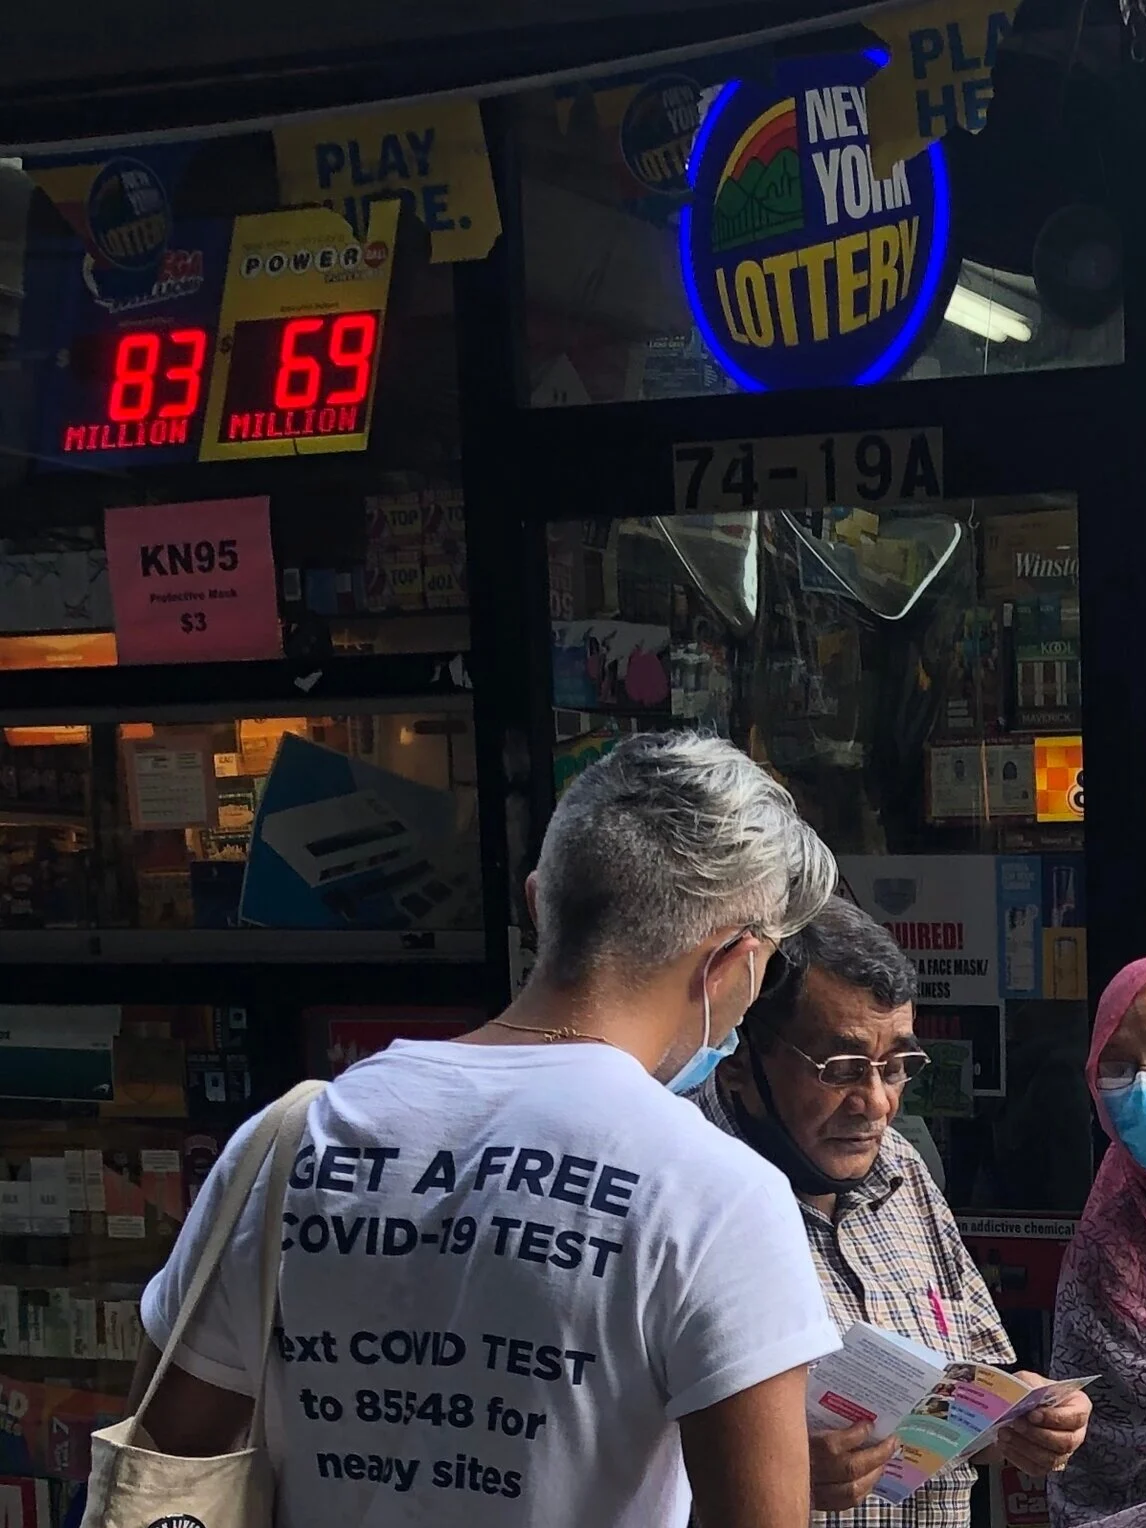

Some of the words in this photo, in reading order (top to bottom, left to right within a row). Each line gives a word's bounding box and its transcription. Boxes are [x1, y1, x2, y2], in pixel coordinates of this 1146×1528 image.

[908, 11, 1016, 80] PLA
[916, 77, 994, 138] HE
[315, 124, 435, 189] PLAY
[245, 243, 362, 276] POWER
[714, 215, 920, 348] LOTTERY
[106, 326, 207, 425] 83
[273, 312, 377, 412] 69
[63, 419, 192, 452] MILLION
[228, 406, 359, 440] MILLION
[674, 433, 941, 510] 74-19A
[447, 506, 464, 522] TO
[140, 538, 239, 578] KN95
[180, 610, 208, 635] $3
[1041, 641, 1075, 655] KOOL
[1021, 711, 1072, 725] MAVERICK
[918, 959, 926, 976] A
[927, 959, 952, 975] FACE
[953, 958, 989, 977] MASK/
[287, 1146, 399, 1193] GET
[412, 1150, 458, 1195] A
[475, 1146, 641, 1218] FREE
[280, 1212, 477, 1257] COVID-19
[491, 1216, 624, 1279] TEST
[971, 1220, 1022, 1234] addictive
[1024, 1221, 1076, 1236] chemical
[349, 1329, 467, 1367] COVID
[482, 1334, 597, 1386] TEST
[300, 1387, 343, 1422] to
[486, 1395, 547, 1441] for
[432, 1454, 522, 1499] sites
[1008, 1492, 1049, 1516] Ca
